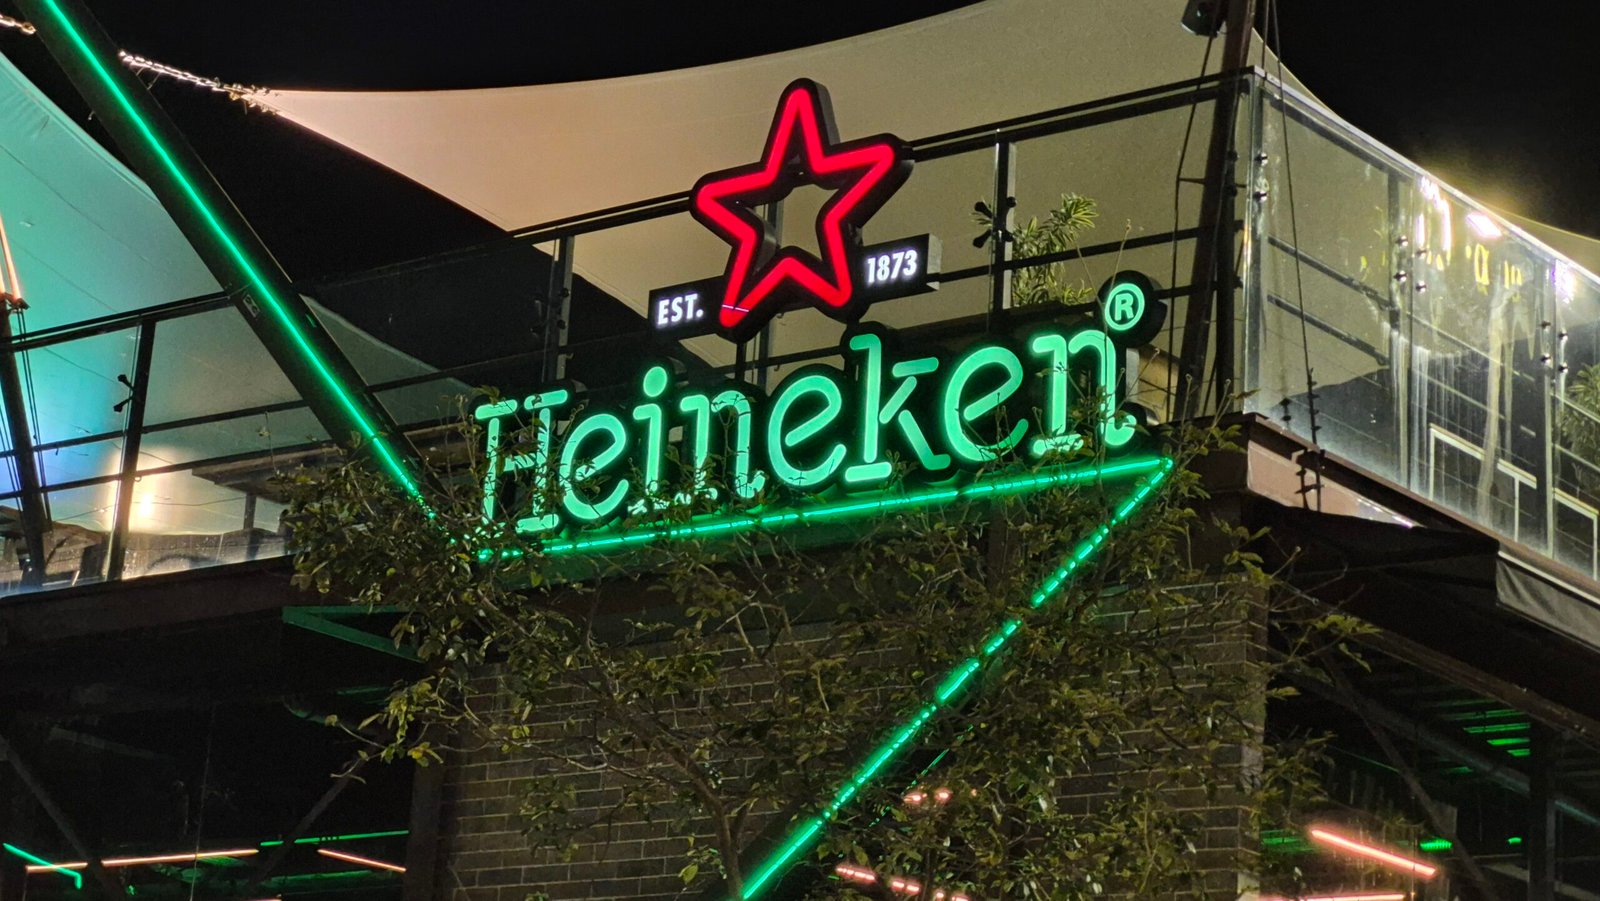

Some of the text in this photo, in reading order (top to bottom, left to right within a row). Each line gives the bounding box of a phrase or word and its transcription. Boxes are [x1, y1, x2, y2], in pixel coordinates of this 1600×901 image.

[656, 249, 918, 327] EST. 1873
[475, 329, 1137, 535] Heineken
